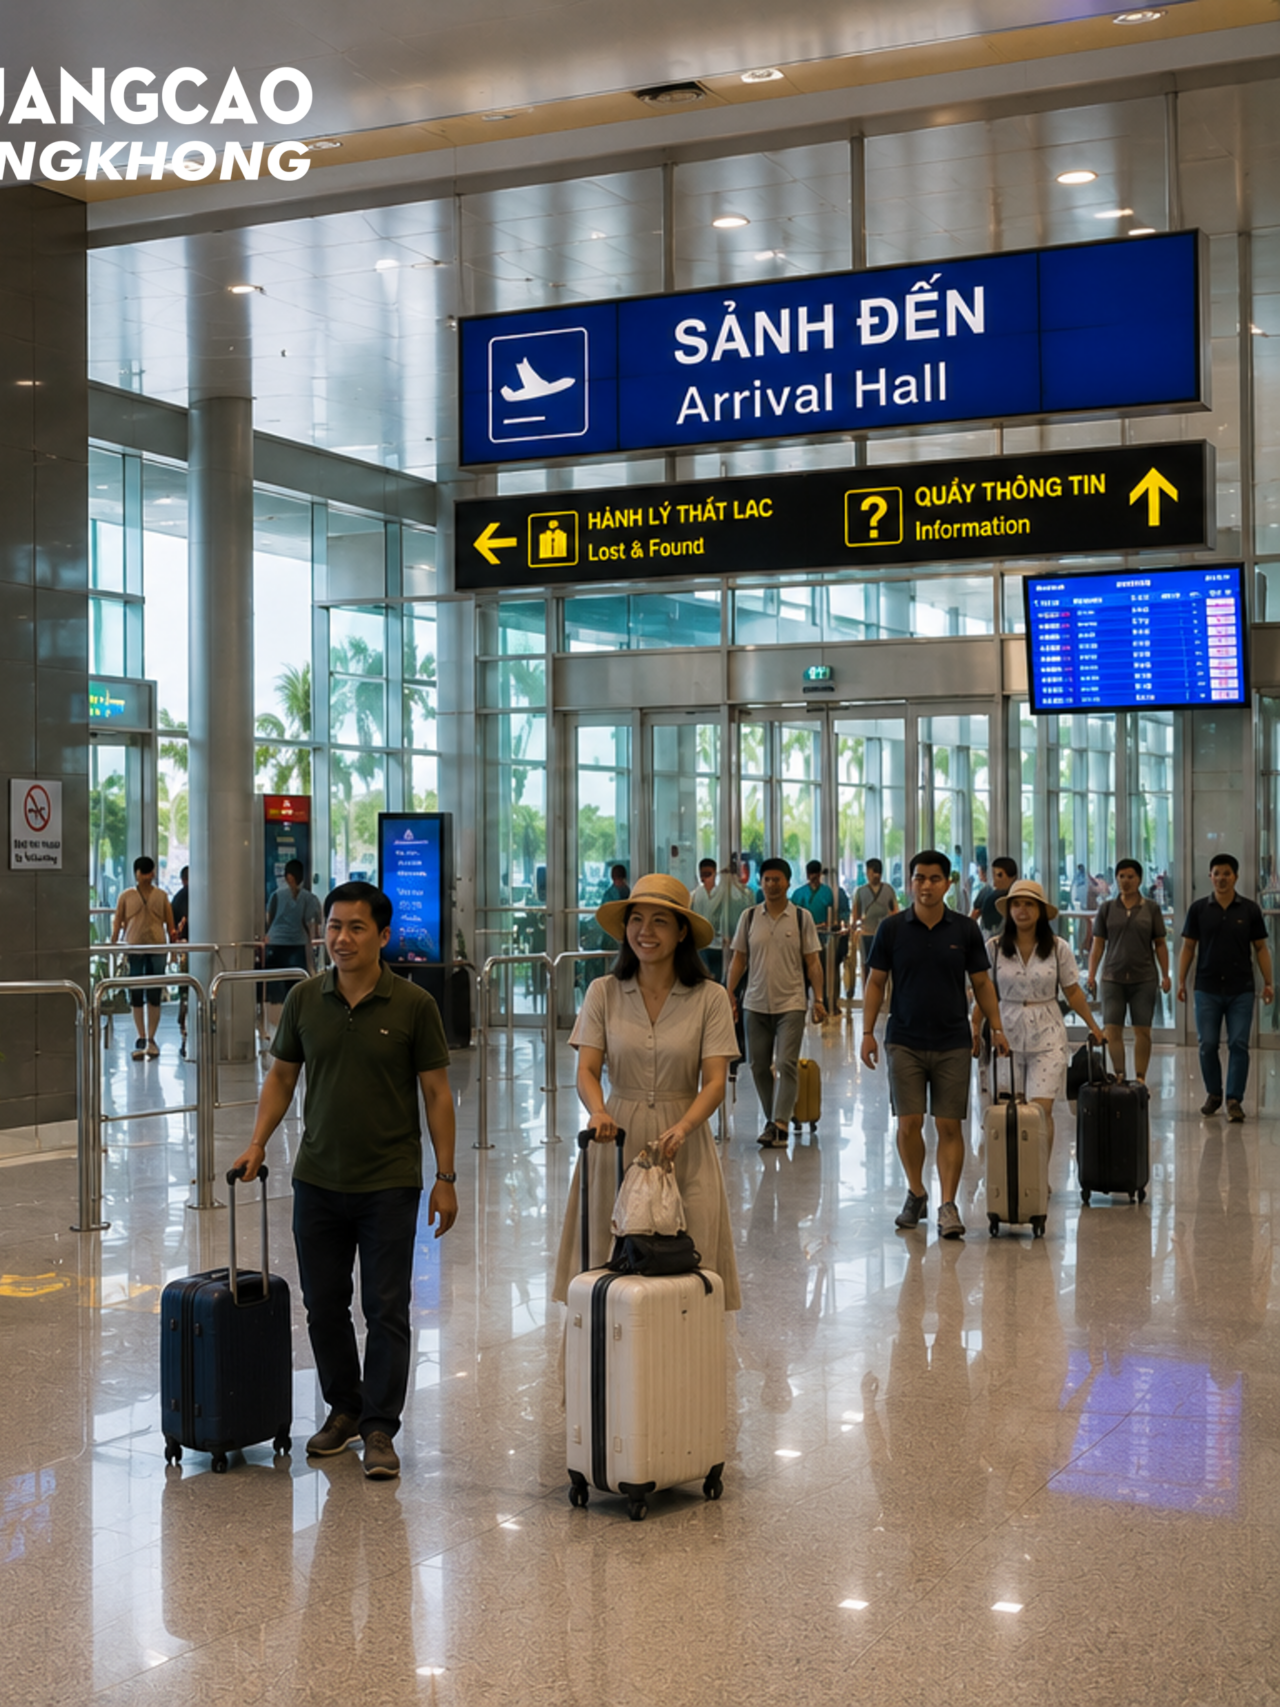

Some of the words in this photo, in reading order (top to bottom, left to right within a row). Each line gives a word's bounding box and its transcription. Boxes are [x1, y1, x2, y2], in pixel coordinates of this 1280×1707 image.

[674, 301, 834, 365] SẢNH
[856, 273, 985, 346] ĐẾN
[676, 373, 833, 425] Arrival
[856, 362, 946, 408] Hall
[981, 474, 1063, 501] THÔNG
[1067, 473, 1106, 496] TIN
[649, 500, 672, 526] LÝ
[915, 515, 1030, 541] Information
[588, 542, 626, 561] Lost
[630, 540, 644, 559] &
[649, 537, 705, 557] Found
